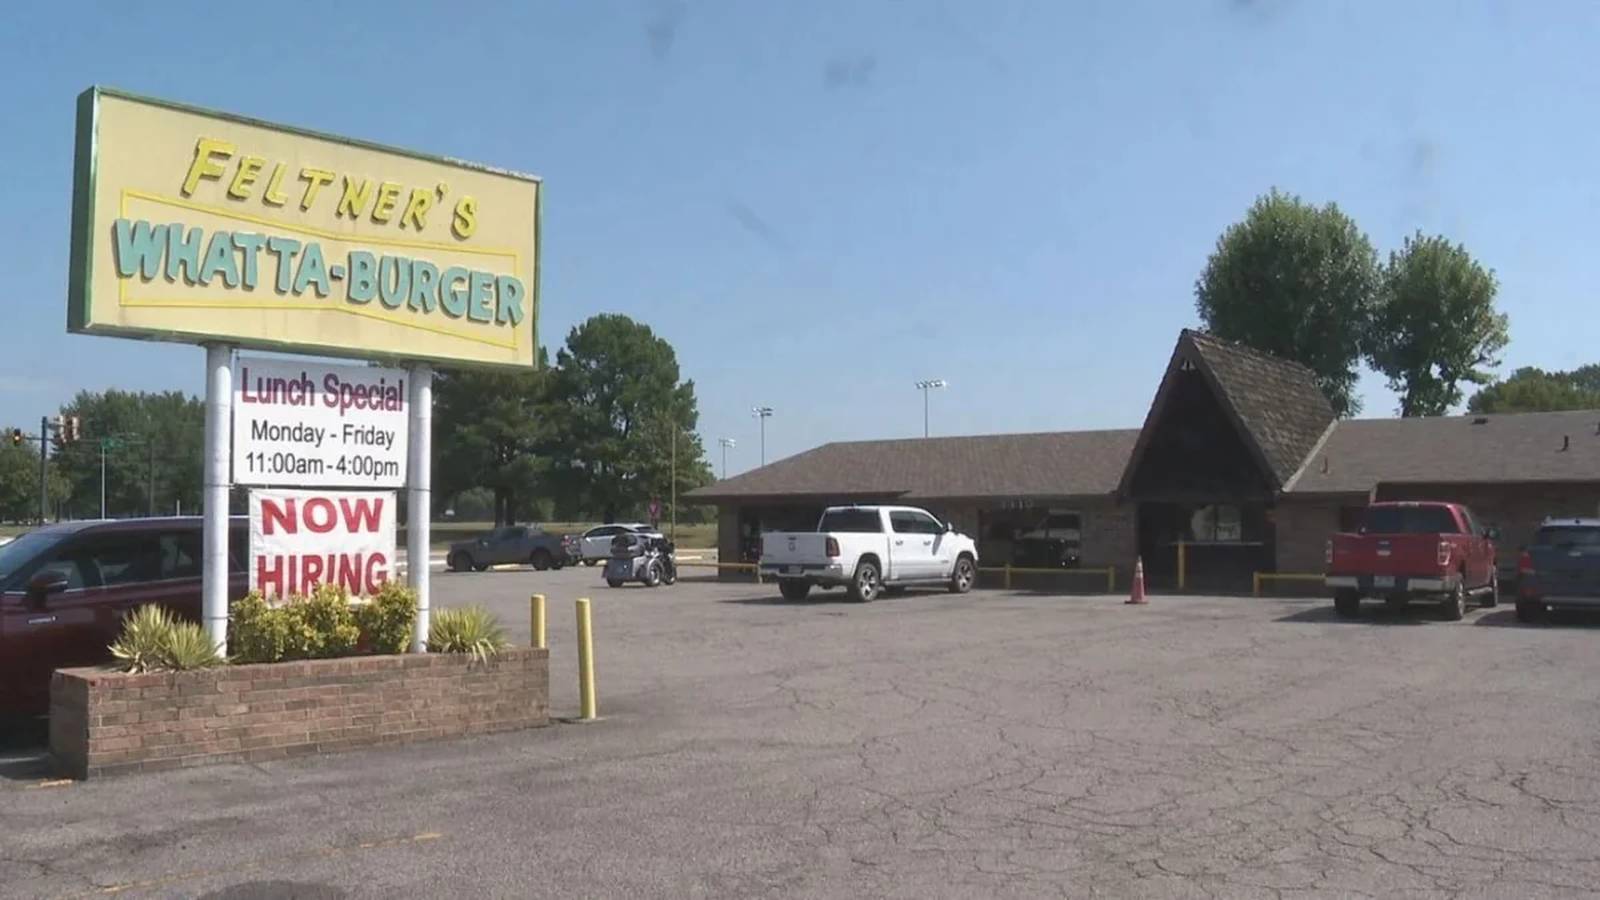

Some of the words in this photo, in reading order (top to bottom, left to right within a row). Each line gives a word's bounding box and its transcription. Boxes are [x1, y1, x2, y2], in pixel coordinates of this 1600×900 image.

[181, 136, 478, 239] FELTNER'S
[112, 218, 525, 328] WHATTA-BURGER
[241, 367, 315, 406] Lunch
[322, 373, 404, 416] Special
[251, 419, 325, 448] Monday
[342, 423, 395, 450] Friday
[261, 498, 384, 535] NOW
[257, 553, 388, 600] HIRING
